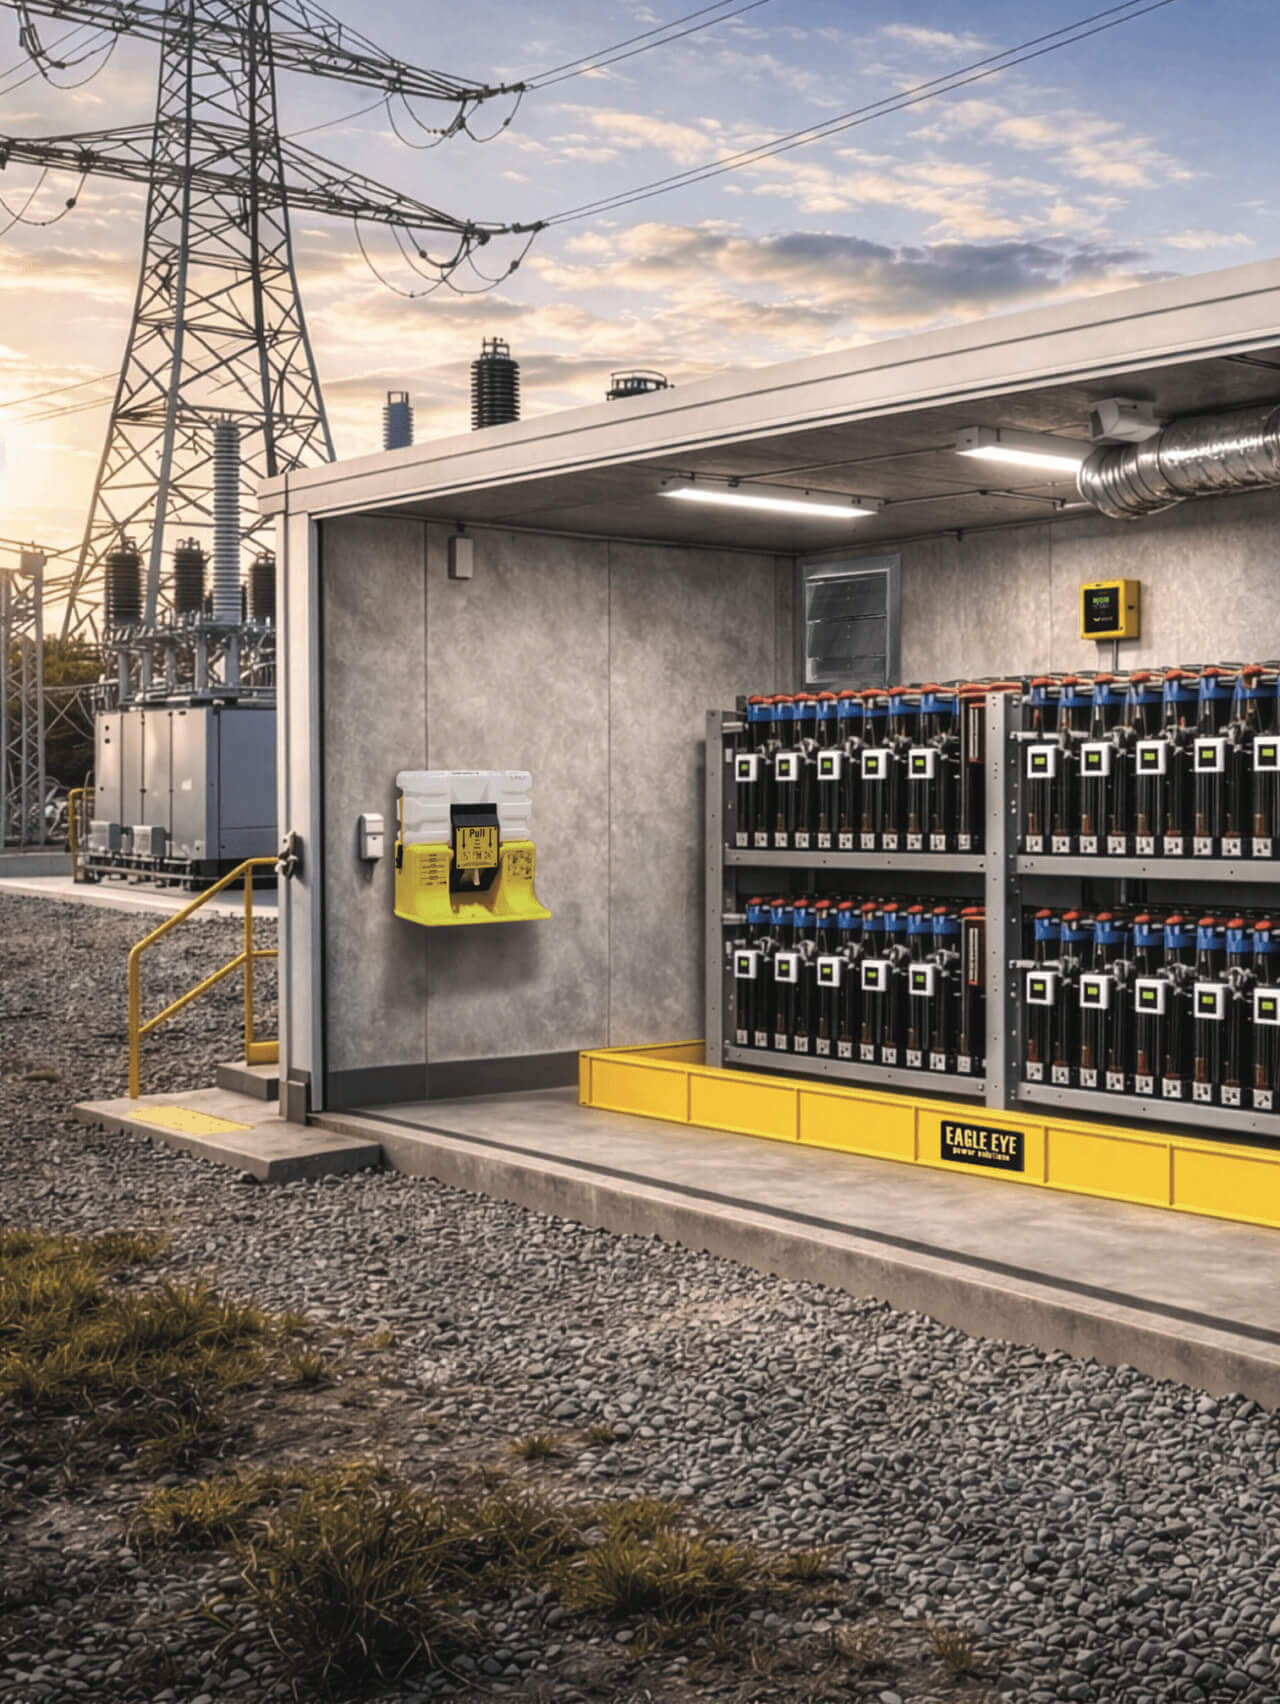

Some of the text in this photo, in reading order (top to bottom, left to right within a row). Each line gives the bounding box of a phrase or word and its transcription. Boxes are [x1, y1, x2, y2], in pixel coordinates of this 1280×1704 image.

[470, 828, 485, 838] Pull
[946, 1126, 1017, 1155] EAGLE EYE
[952, 1147, 976, 1156] power
